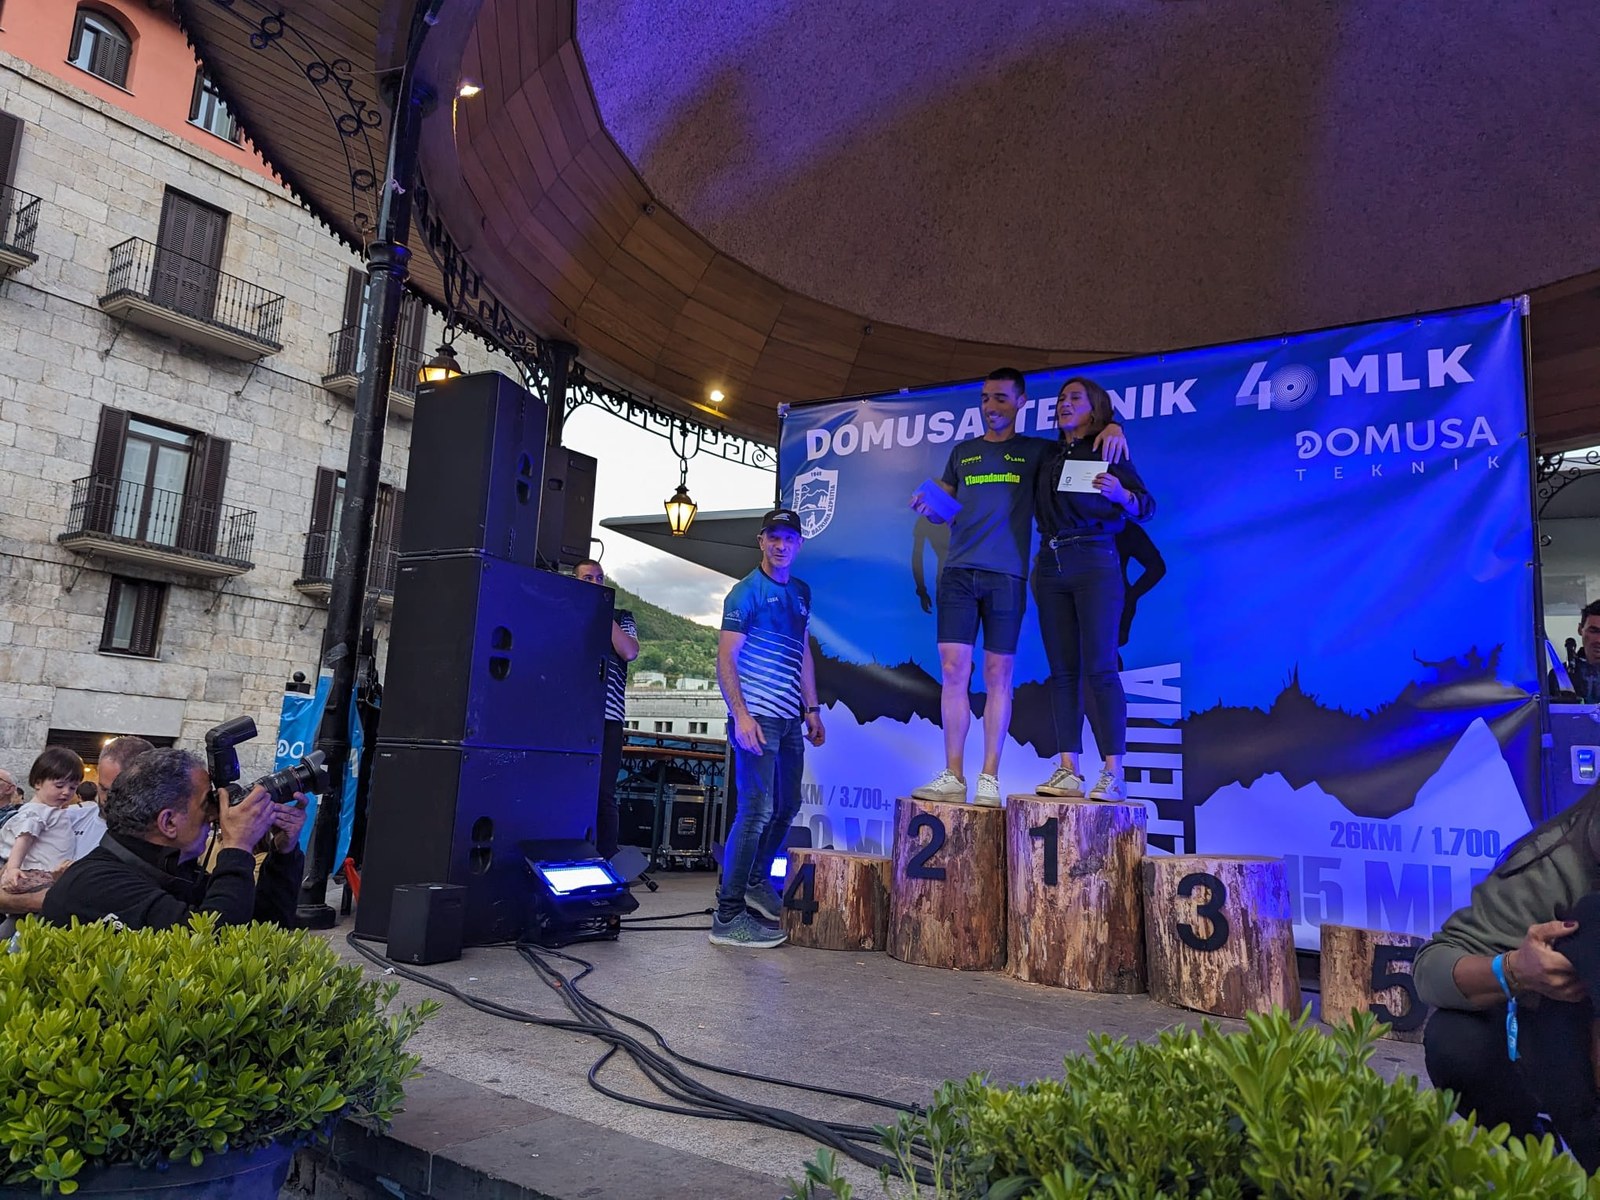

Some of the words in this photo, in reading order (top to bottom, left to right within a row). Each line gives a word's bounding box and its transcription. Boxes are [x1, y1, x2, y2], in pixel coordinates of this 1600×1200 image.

[806, 407, 985, 461] DOMUSA
[1014, 378, 1198, 433] TENIK
[1330, 344, 1474, 396] MLK
[1295, 416, 1499, 460] DOMUSA
[1295, 456, 1499, 481] TEKNIK
[840, 786, 891, 810] 3.700+
[906, 813, 947, 881] 2
[1029, 817, 1059, 886] 1
[1330, 820, 1402, 852] 26KM
[783, 863, 818, 925] 4
[1177, 872, 1229, 952] 3
[1369, 944, 1428, 1032] 5
